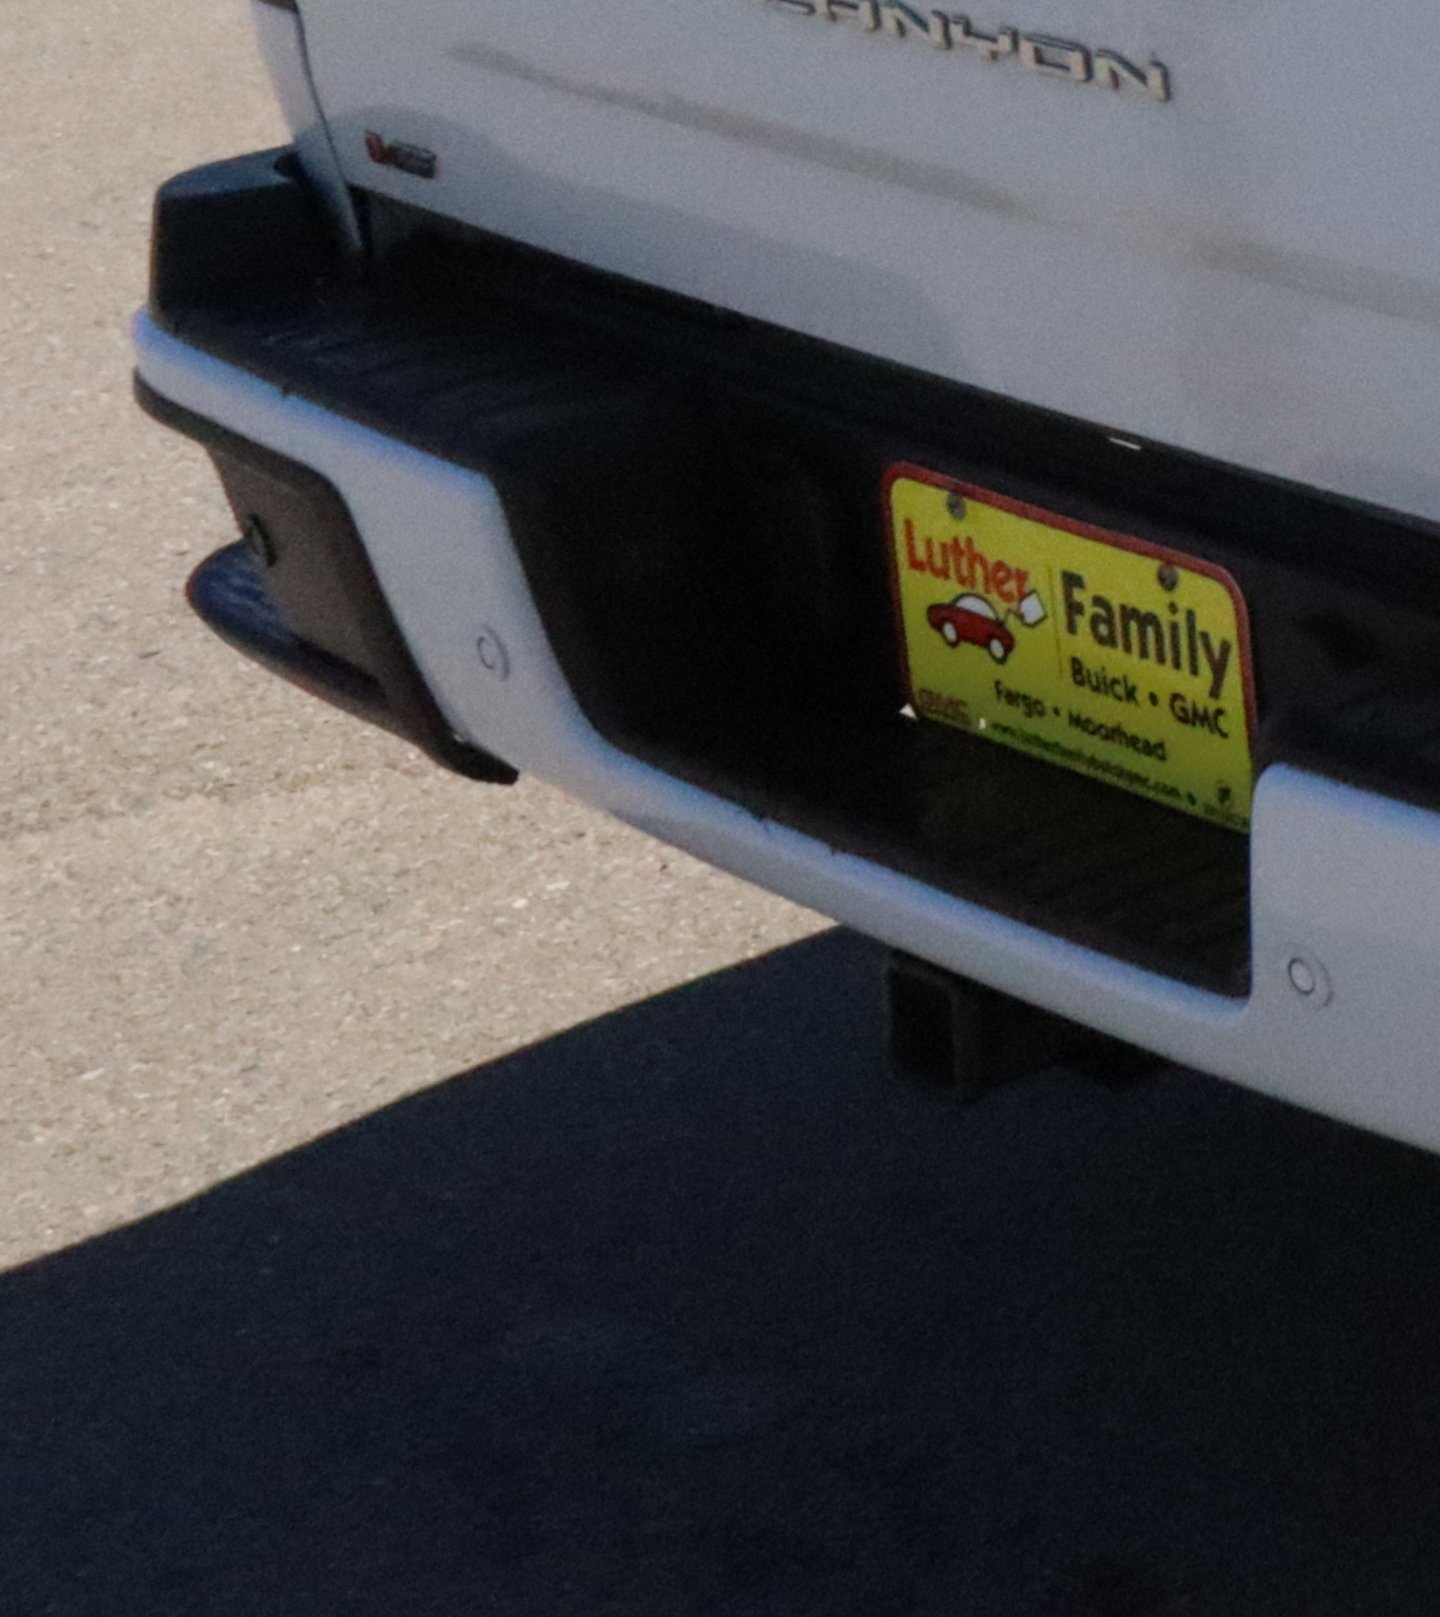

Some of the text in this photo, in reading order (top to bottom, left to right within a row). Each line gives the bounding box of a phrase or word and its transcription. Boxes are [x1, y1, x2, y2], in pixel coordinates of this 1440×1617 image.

[903, 518, 1231, 700] Luther Family
[994, 681, 1047, 719] Fargo
[1069, 709, 1168, 762] Moorhead
[1071, 657, 1229, 739] Buick GMC
